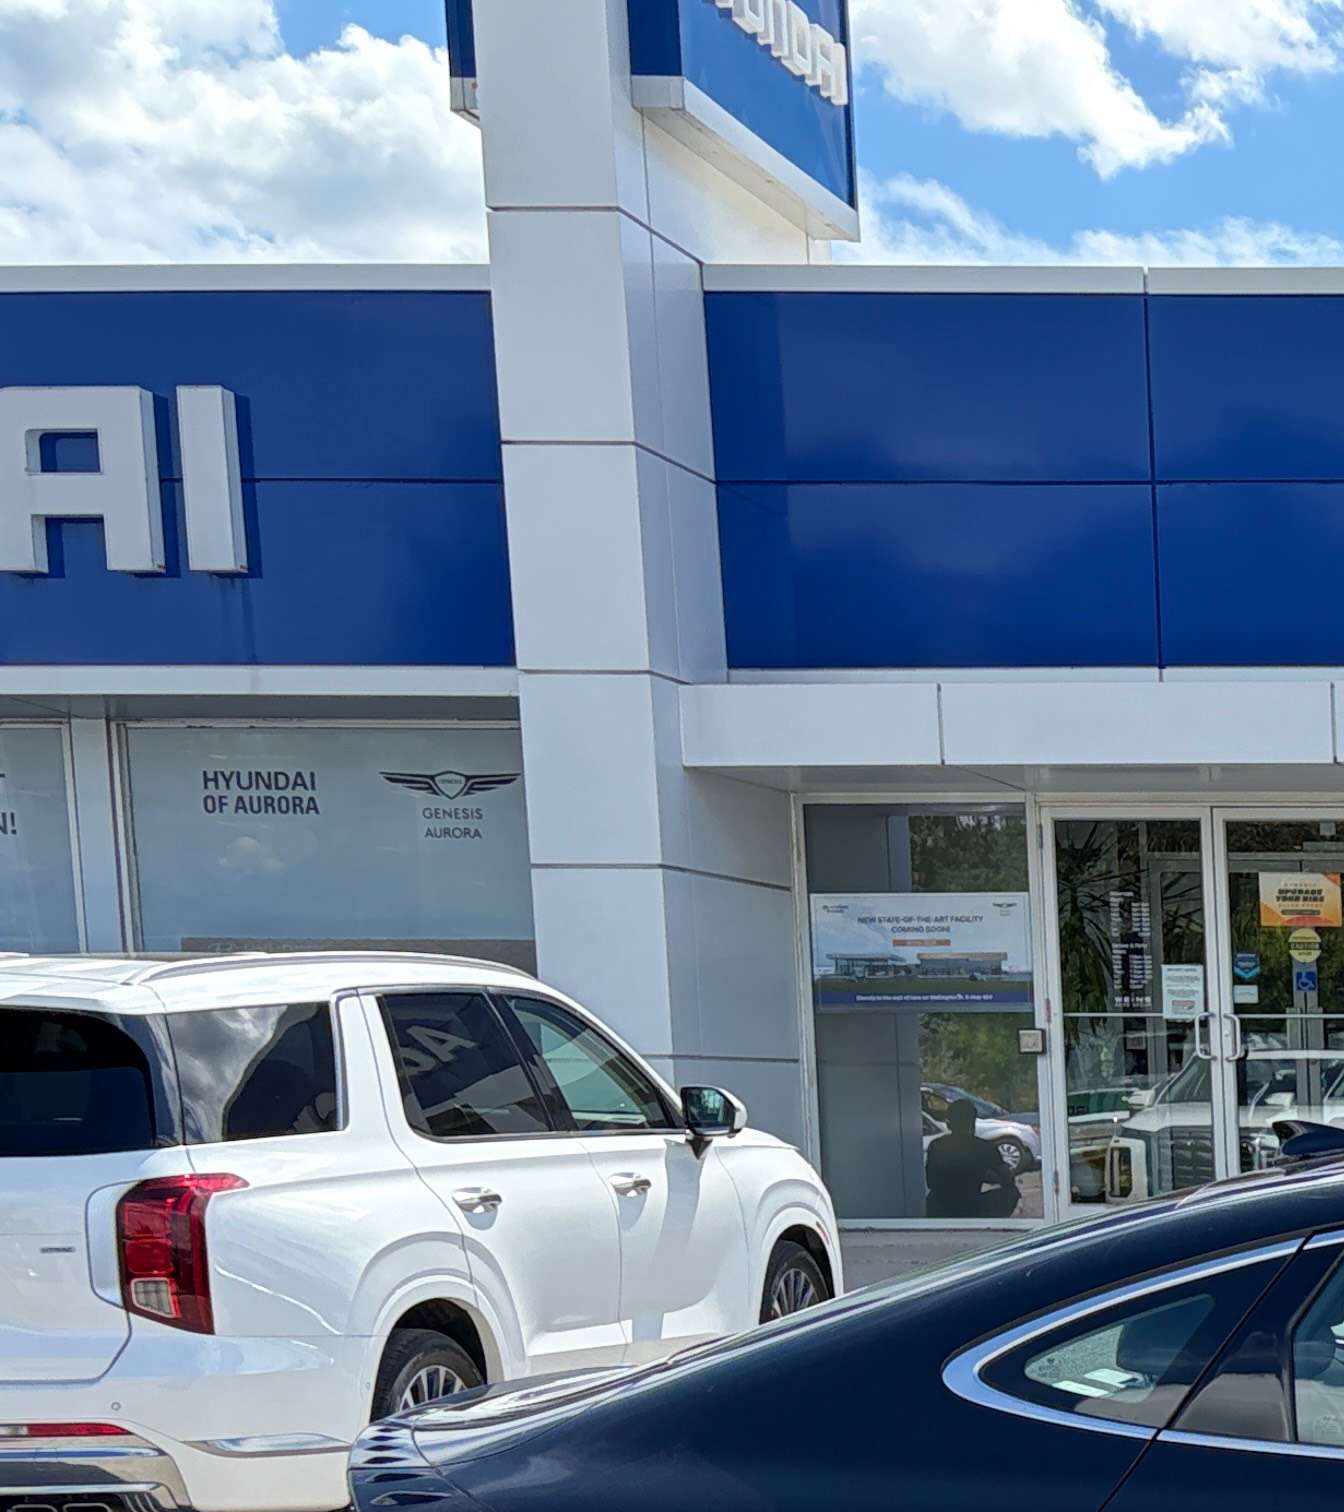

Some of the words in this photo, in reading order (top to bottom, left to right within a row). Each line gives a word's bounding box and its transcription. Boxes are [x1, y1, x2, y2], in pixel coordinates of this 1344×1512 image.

[202, 770, 317, 791] HYUNDAI
[203, 794, 229, 814] OF
[234, 795, 321, 815] AURORA
[422, 807, 484, 820] GENESIS
[424, 827, 482, 839] AURORA
